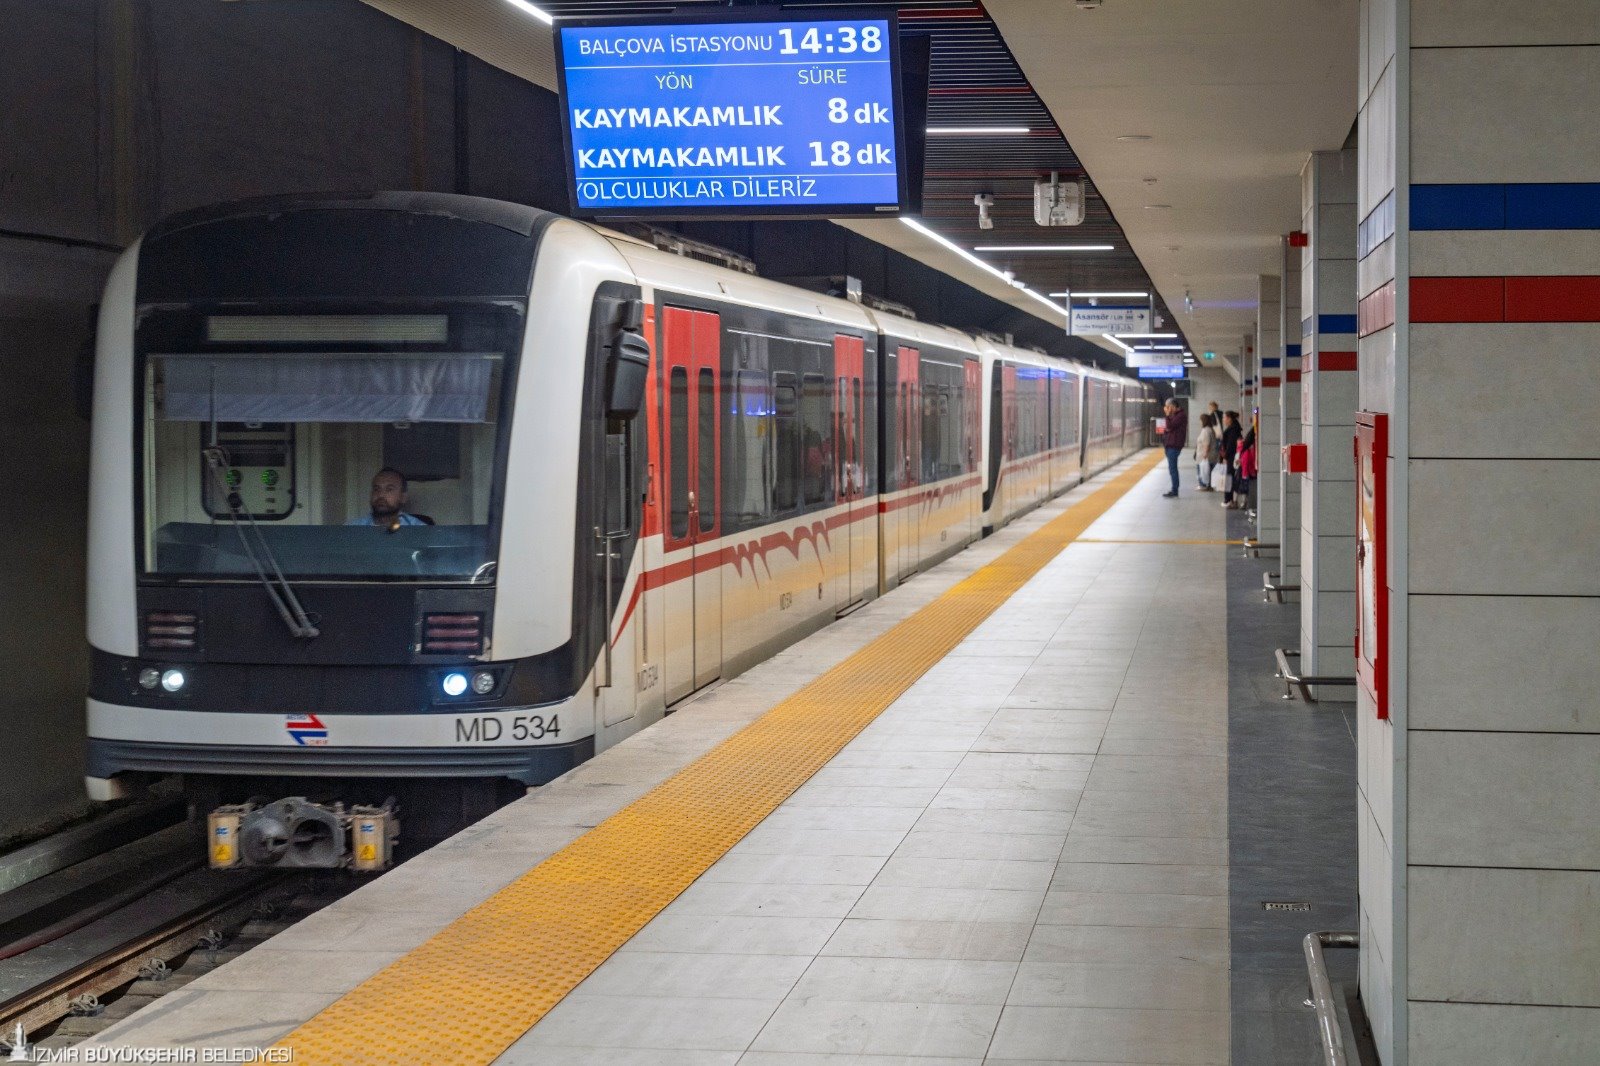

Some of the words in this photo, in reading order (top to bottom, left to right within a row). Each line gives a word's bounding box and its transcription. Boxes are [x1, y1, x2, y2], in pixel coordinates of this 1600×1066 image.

[579, 38, 665, 57] BALÇOVA
[670, 34, 773, 53] İSTASYONU
[778, 26, 882, 55] 14:38
[655, 71, 693, 90] YÖN
[798, 66, 848, 85] SÜRE
[573, 105, 784, 129] KAYMAKAMLIK
[828, 97, 849, 124] 8
[853, 102, 890, 124] dk
[578, 146, 786, 169] KAYMAKAMLIK
[808, 140, 852, 167] 18
[856, 143, 893, 165] dk
[732, 175, 818, 198] DİLERİZ
[1075, 313, 1109, 321] Asansör
[456, 717, 503, 742] MD
[512, 713, 562, 741] 534
